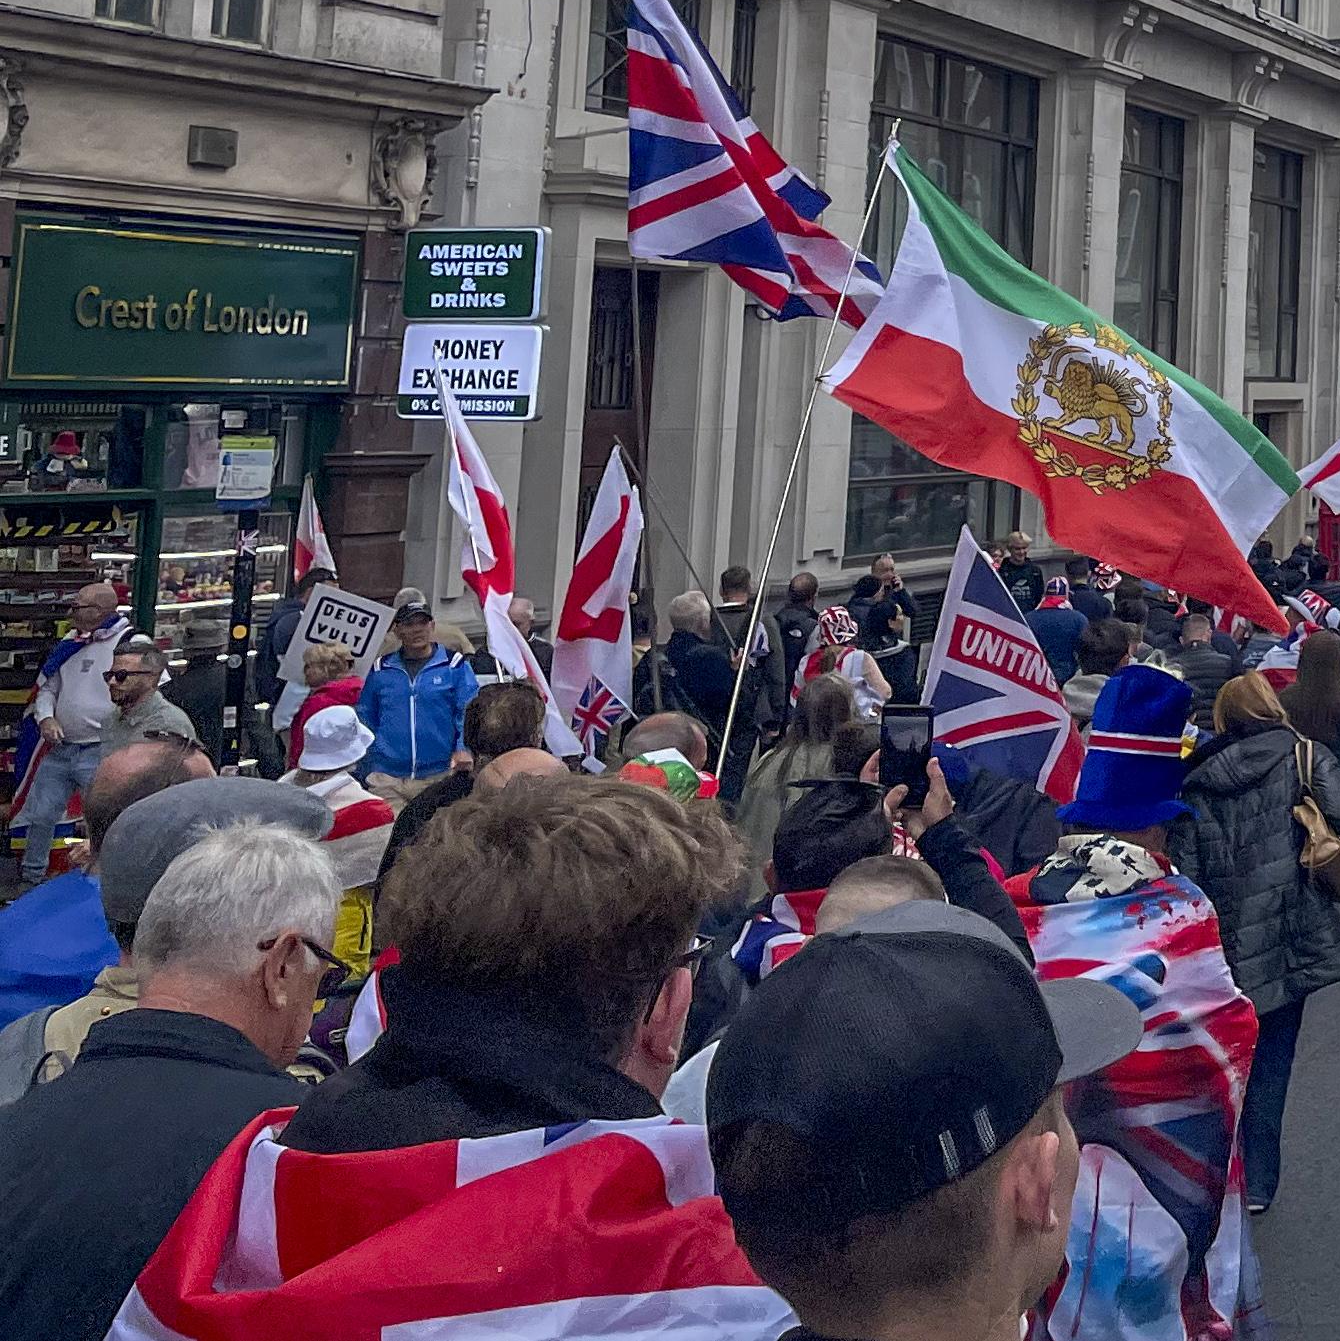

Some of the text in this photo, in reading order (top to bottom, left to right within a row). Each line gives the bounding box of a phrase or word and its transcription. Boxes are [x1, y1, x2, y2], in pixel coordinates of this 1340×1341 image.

[418, 244, 523, 260] AMERICAN
[430, 262, 509, 276] SWEETS
[460, 277, 477, 292] &
[430, 293, 506, 308] DRINKS
[74, 285, 309, 335] Crest of London
[432, 339, 505, 360] MONEY
[411, 399, 515, 412] 0% CMISSION
[323, 604, 370, 628] DEUS
[317, 622, 362, 647] VULT
